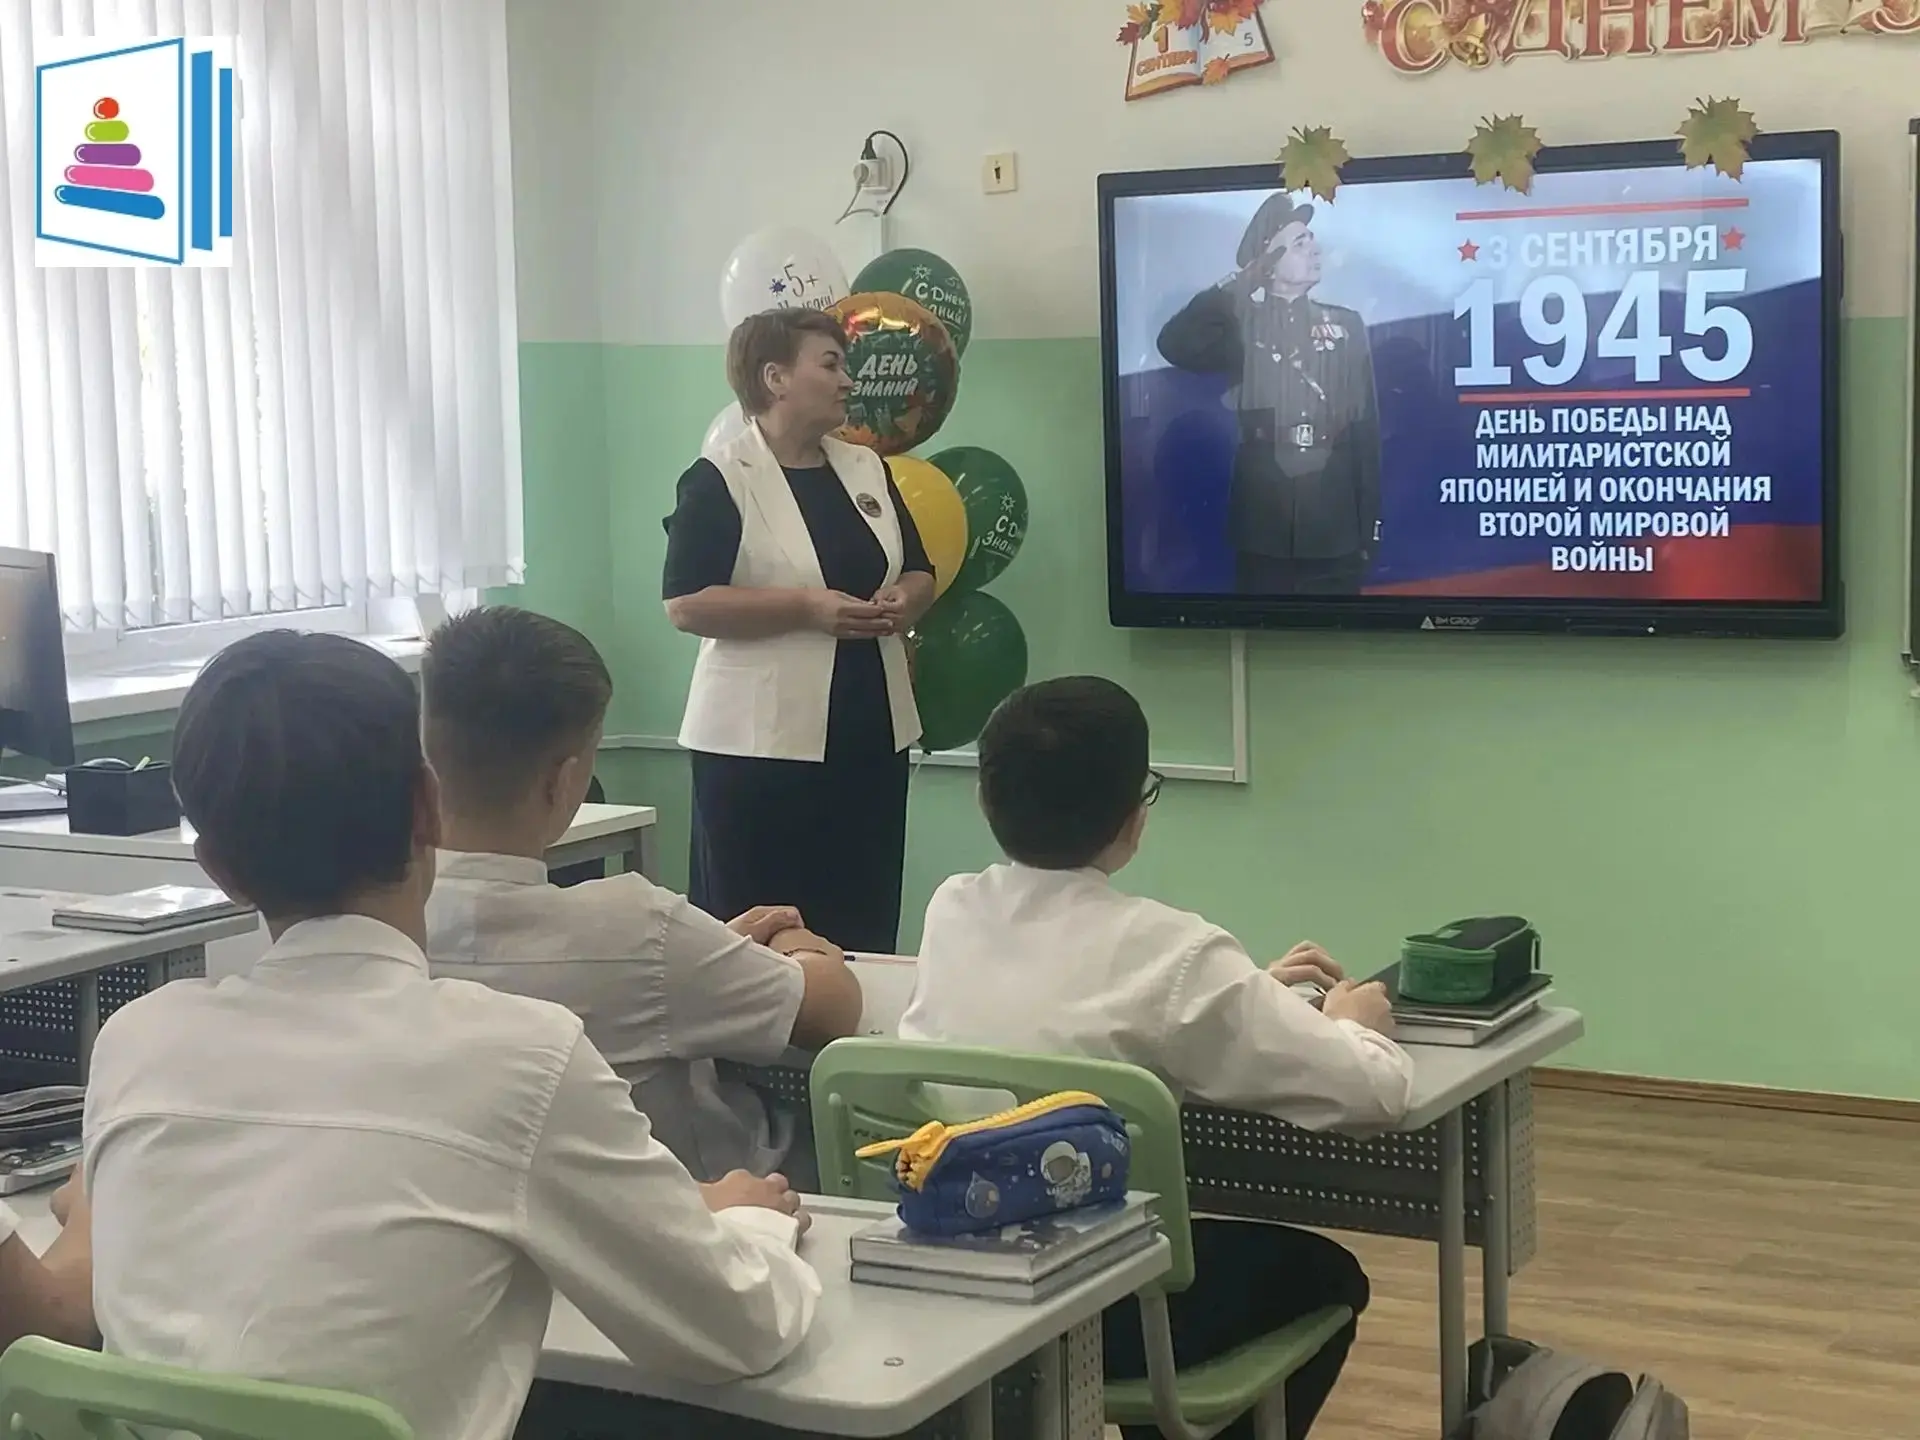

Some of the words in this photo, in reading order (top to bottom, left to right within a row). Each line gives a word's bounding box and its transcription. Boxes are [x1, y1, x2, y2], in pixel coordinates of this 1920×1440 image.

[1153, 25, 1169, 54] 1
[1243, 31, 1255, 47] 5
[1488, 236, 1509, 268] 3
[1520, 224, 1718, 267] СЕНТЯБРЯ
[784, 263, 819, 298] 5+
[1453, 268, 1754, 387] 1945
[857, 353, 918, 379] ДЕНЬ
[850, 377, 919, 397] ЗНАНИЙ
[1475, 407, 1545, 438] ДЕНЬ
[1552, 405, 1667, 437] ПОБЕДЫ
[1675, 405, 1732, 436] НАД
[1476, 434, 1731, 469] МИЛИТАРИСТСКОЙ
[1440, 472, 1566, 503] ЯПОНИЕЙ
[1574, 478, 1592, 503] И
[1600, 476, 1772, 503] ОКОНЧАНИЯ
[1479, 507, 1582, 537] ВТОРОЙ
[1590, 505, 1730, 537] МИРОВОЙ
[1552, 541, 1654, 572] ВОЙНЫ
